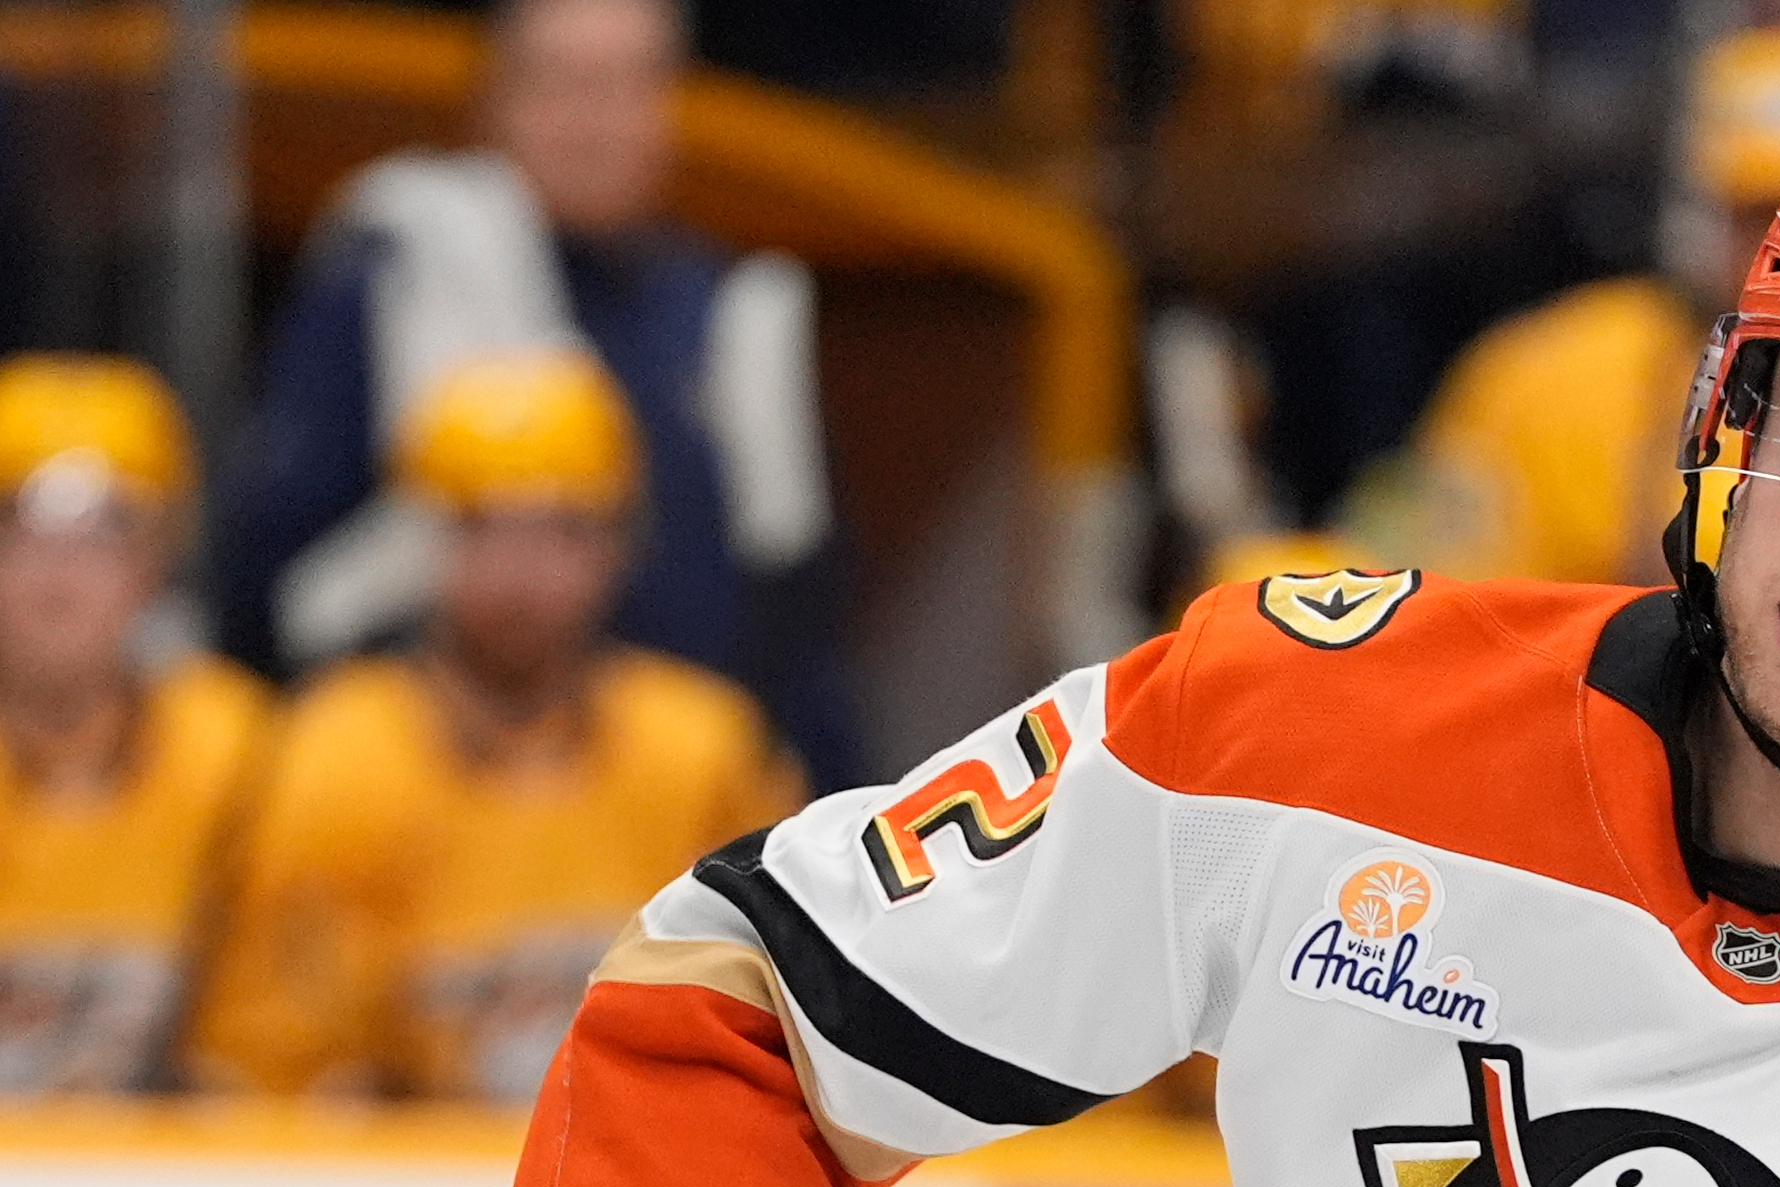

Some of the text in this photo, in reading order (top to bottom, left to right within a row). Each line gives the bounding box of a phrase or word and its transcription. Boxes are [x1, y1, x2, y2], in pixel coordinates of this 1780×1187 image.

[1346, 938, 1387, 963] visit
[1728, 945, 1772, 966] NHL
[1290, 919, 1487, 1030] Anaheim
